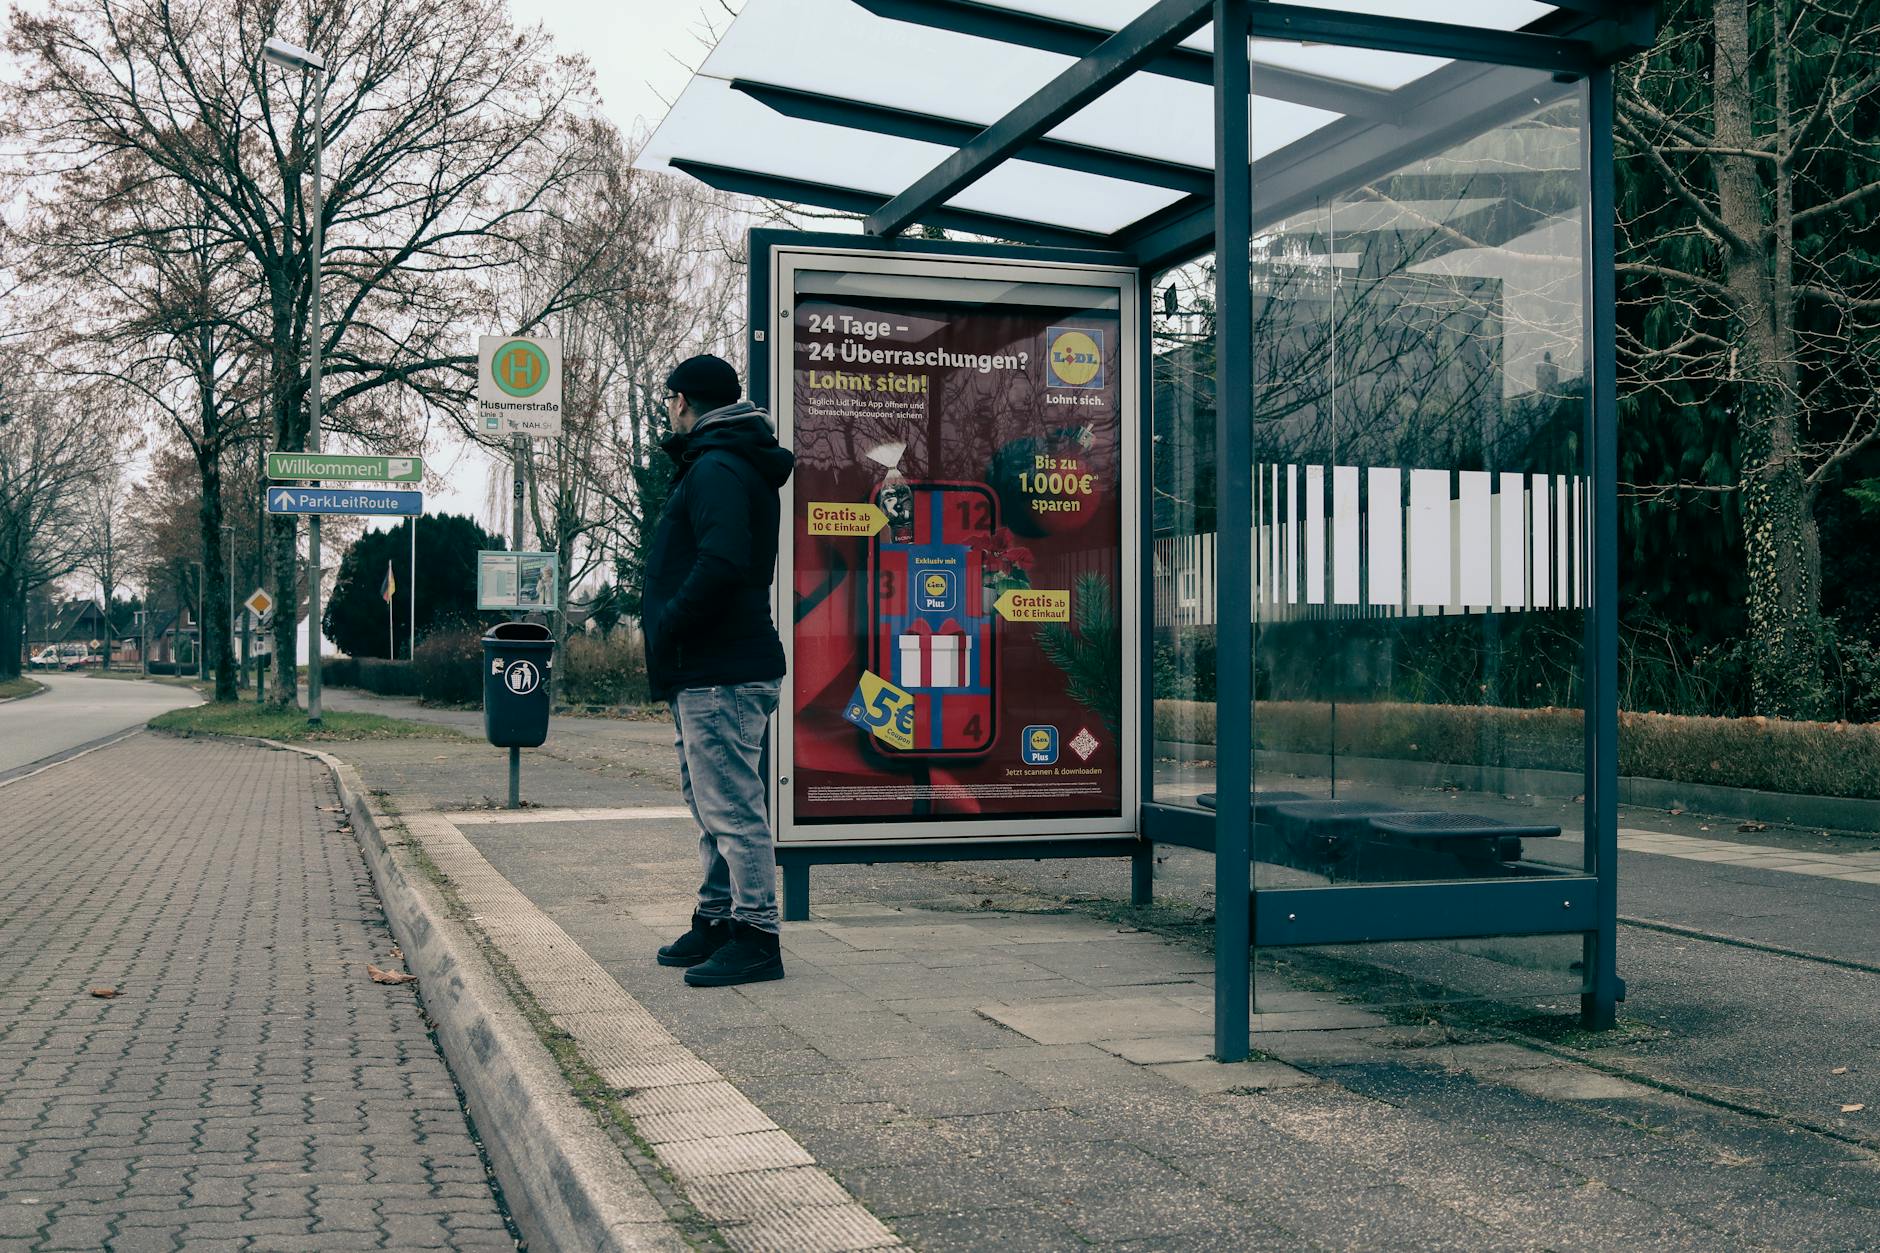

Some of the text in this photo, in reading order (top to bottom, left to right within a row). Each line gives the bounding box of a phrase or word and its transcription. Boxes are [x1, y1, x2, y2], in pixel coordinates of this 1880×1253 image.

[808, 314, 835, 333] 24
[839, 315, 891, 340] Tage
[808, 338, 1029, 373] 24 Überraschungen?
[509, 353, 533, 386] H
[809, 370, 928, 393] Lohnt sich!
[480, 400, 560, 412] Husumerstraße
[808, 397, 835, 407] Täglich
[836, 399, 850, 407] Lidl
[868, 400, 884, 409] App
[884, 400, 909, 409] öffnen
[910, 402, 925, 410] und
[1046, 394, 1105, 406] Lohnt sich.
[896, 411, 923, 419] sichern
[276, 459, 382, 476] Willkommen!
[1034, 454, 1077, 470] Bis zu
[300, 495, 399, 509] ParkLeitRoute
[1031, 499, 1081, 514] sparen
[812, 507, 871, 521] Gratis ab
[956, 501, 991, 531] 12
[812, 522, 870, 532] 10 € Einkauf
[915, 557, 956, 565] Exklusiv mit
[926, 598, 945, 608] Plus
[1012, 595, 1066, 608] Gratis ab
[1012, 609, 1065, 618] 10 € Einkauf
[962, 714, 983, 742] 4
[887, 728, 911, 745] Coupon
[1031, 752, 1049, 762] Plus
[1005, 767, 1103, 777] Jetzt scannen & downloaden
